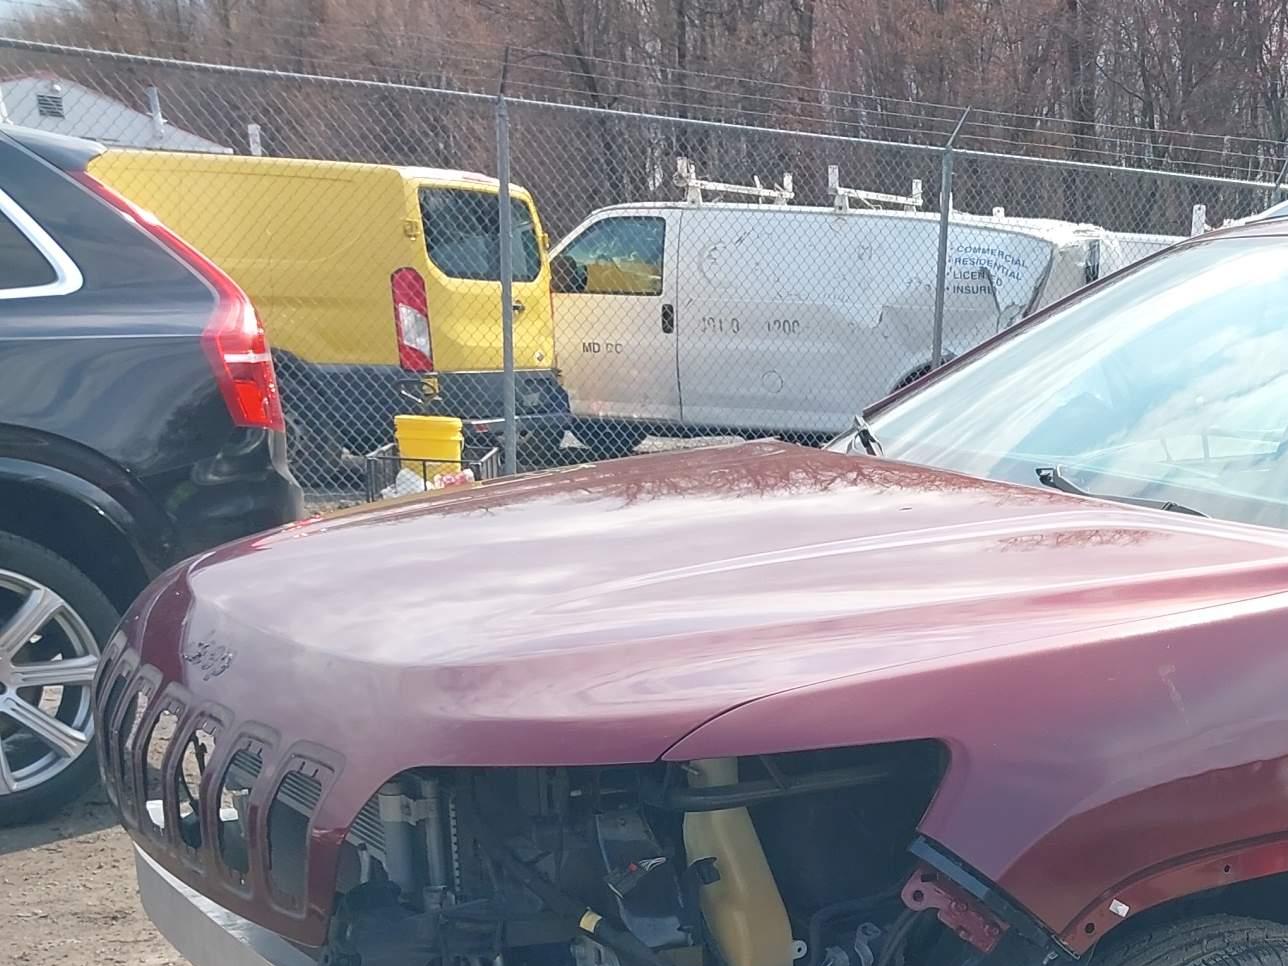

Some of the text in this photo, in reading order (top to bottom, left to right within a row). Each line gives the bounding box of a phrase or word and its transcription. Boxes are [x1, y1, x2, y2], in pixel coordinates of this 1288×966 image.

[956, 245, 1027, 269] COMMERCIAL
[954, 257, 1022, 281] RESIDENTIAL
[953, 270, 1003, 287] LICENED
[953, 285, 996, 295] INSUR
[582, 342, 601, 353] MD
